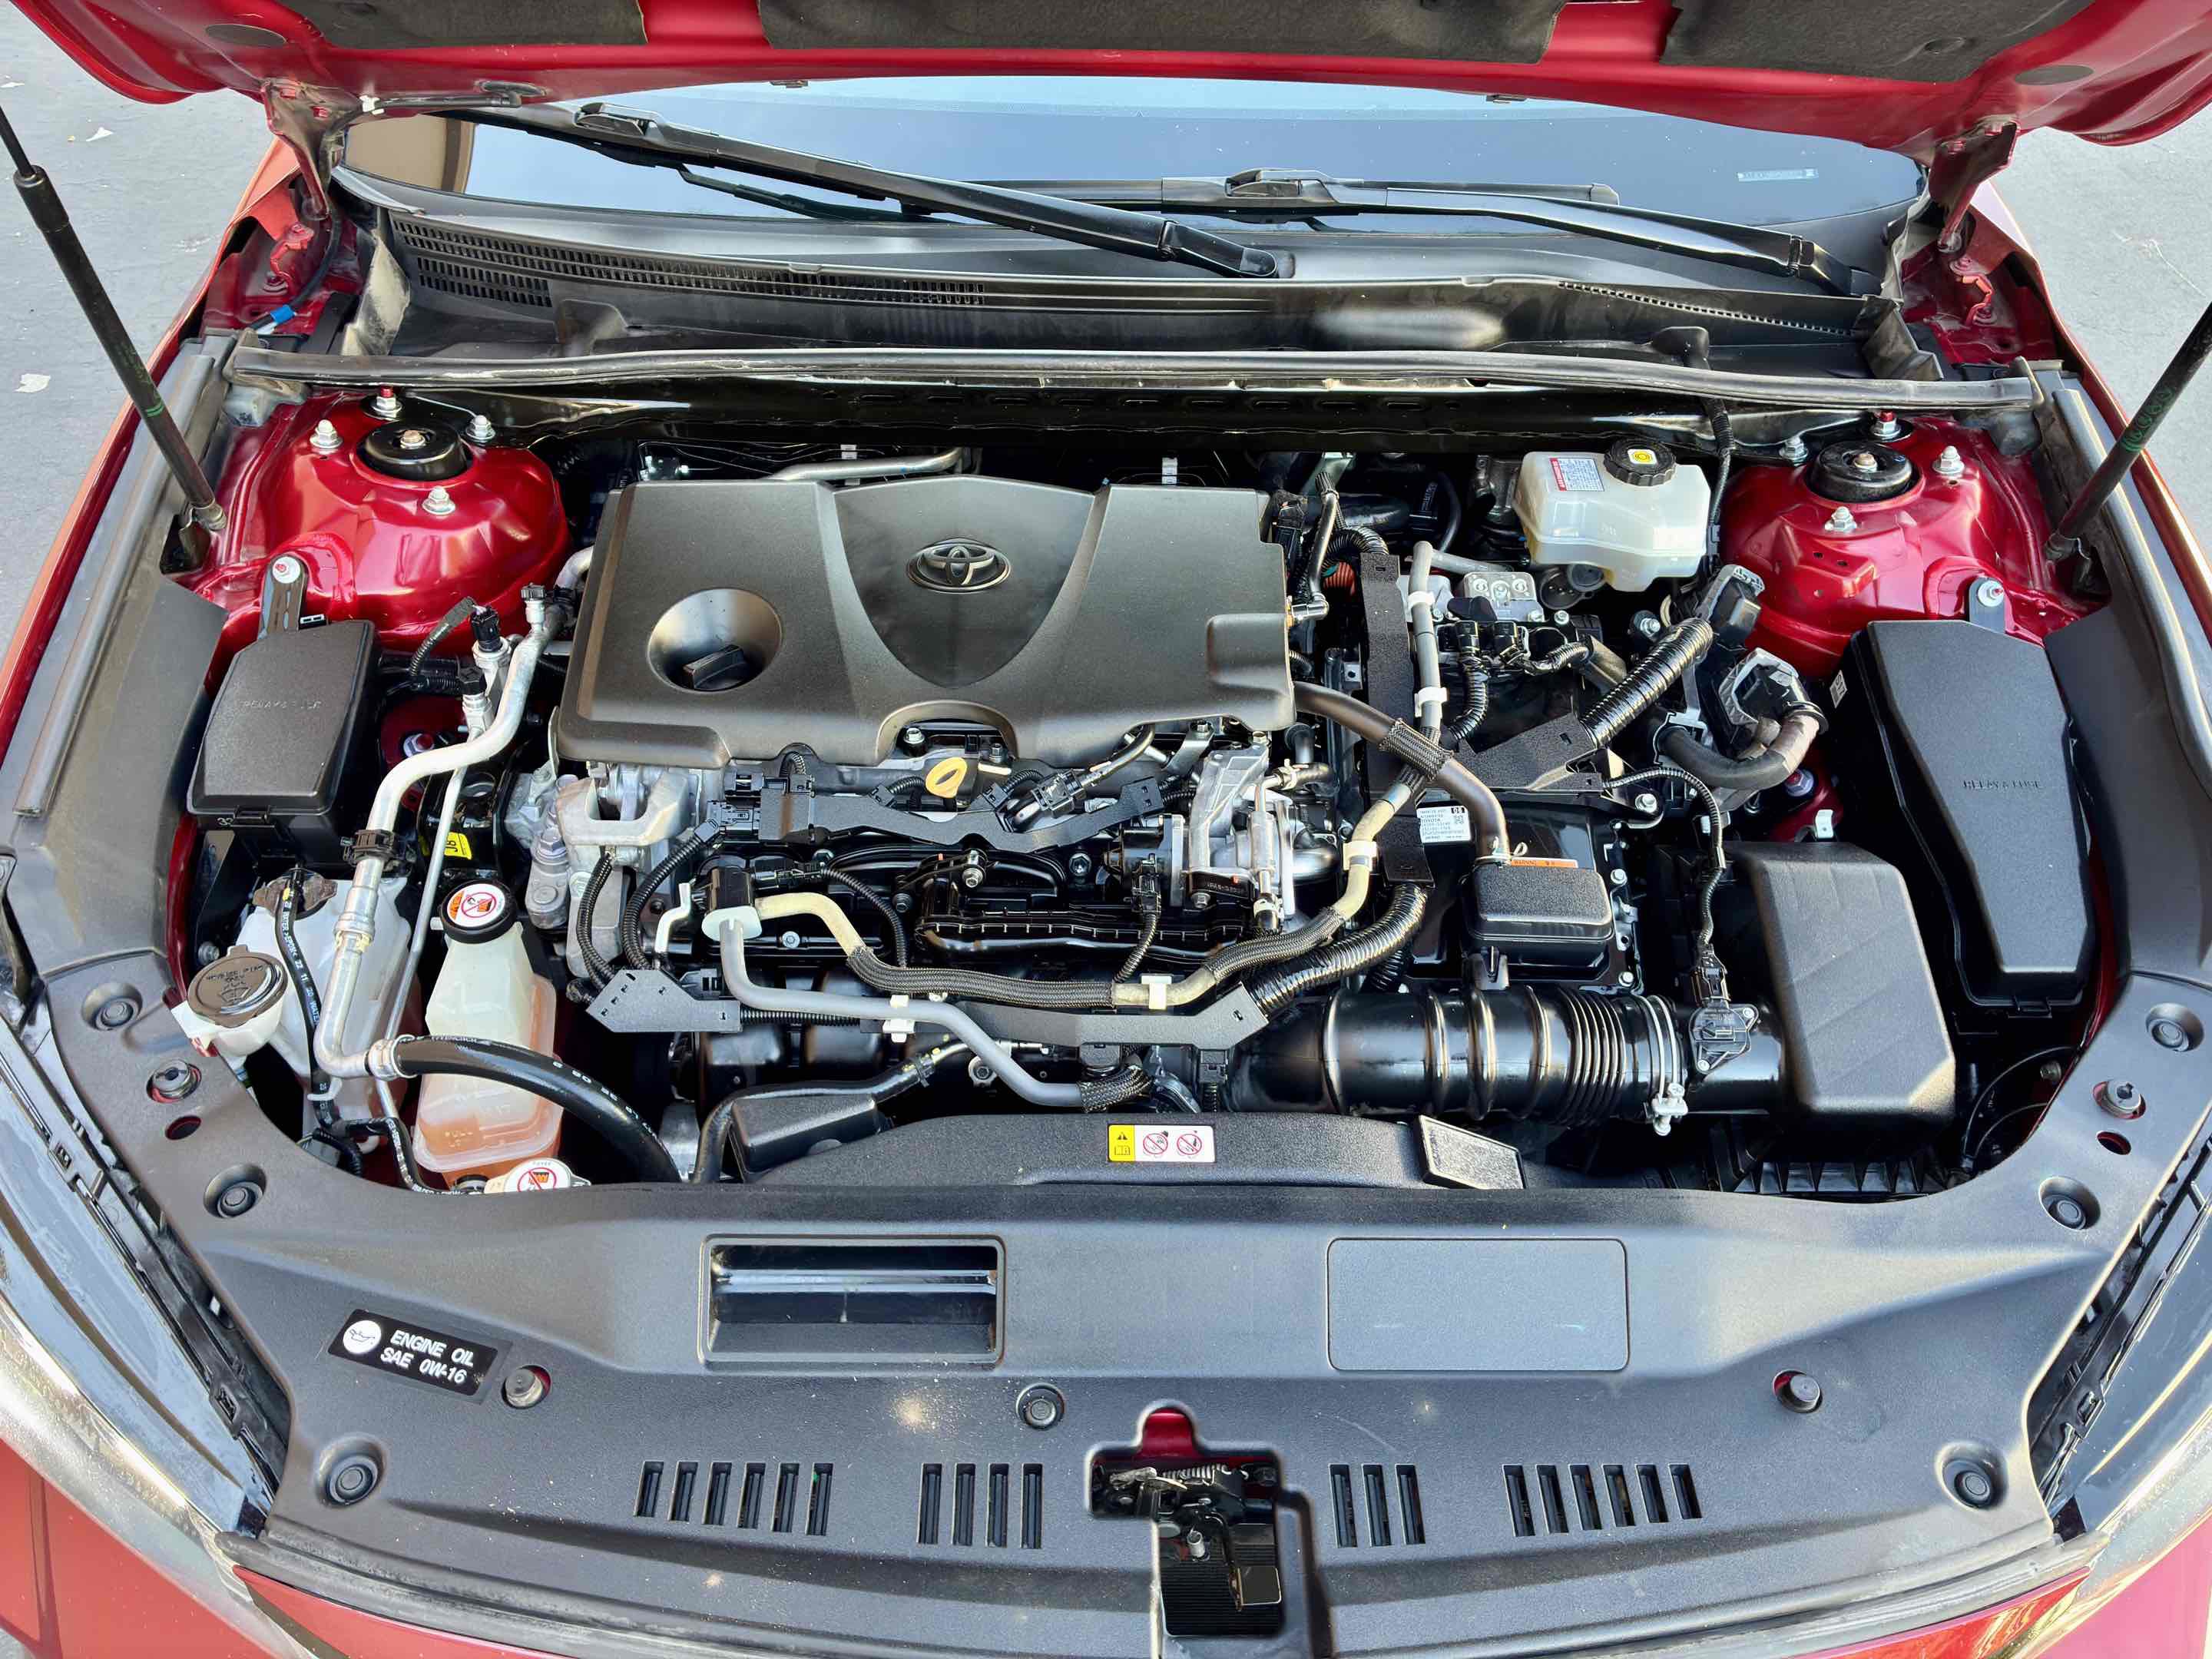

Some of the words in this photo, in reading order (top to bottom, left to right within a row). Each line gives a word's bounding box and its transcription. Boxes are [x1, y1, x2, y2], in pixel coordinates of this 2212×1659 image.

[380, 1347, 415, 1369] SAE
[419, 1358, 467, 1384] 0W-16
[390, 1330, 447, 1358] ENGINE
[451, 1347, 475, 1367] OIL
